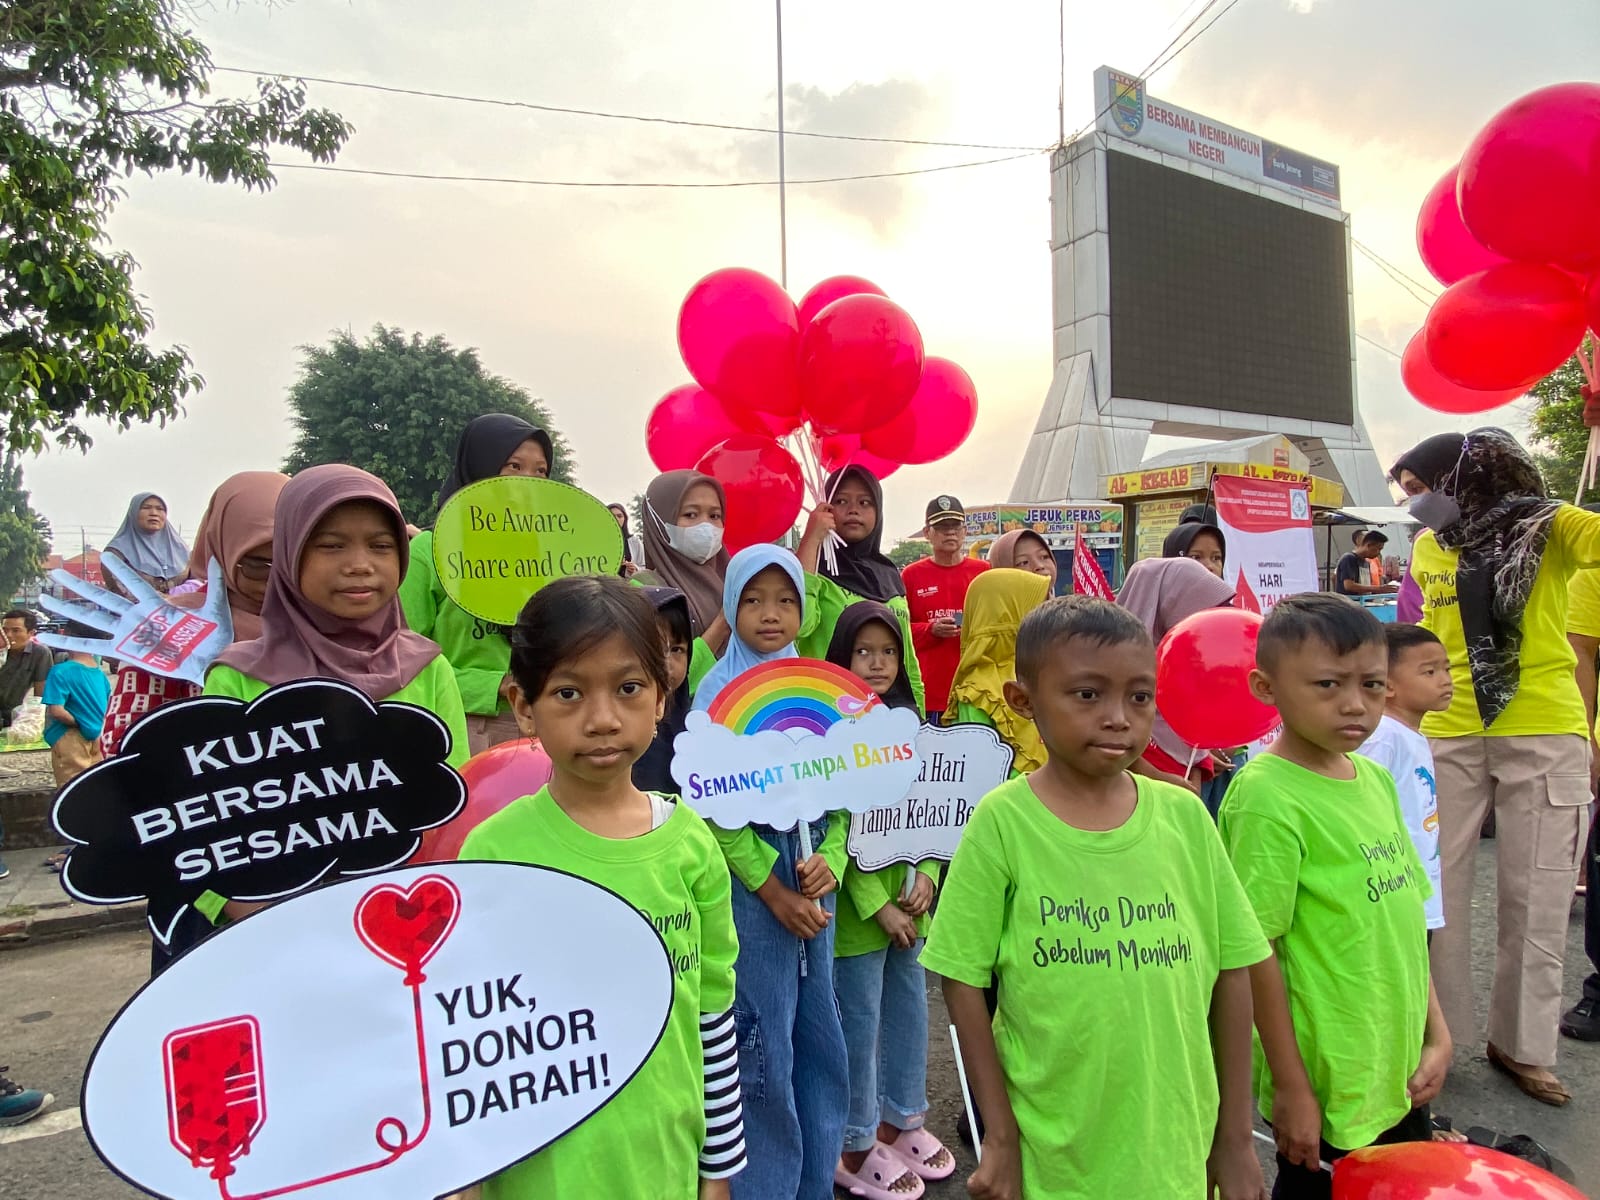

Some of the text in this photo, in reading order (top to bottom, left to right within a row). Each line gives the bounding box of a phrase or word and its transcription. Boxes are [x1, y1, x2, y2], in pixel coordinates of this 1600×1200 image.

[1147, 103, 1260, 158] BERSAMA MEMBANGUN
[1188, 139, 1225, 165] NEGERI
[1110, 477, 1128, 494] AL
[1140, 468, 1188, 491] KEBAB
[470, 505, 575, 535] Be Aware,
[972, 511, 997, 522] PERAS
[1024, 509, 1102, 523] JERUK PERAS
[447, 551, 608, 580] Share and Care
[1259, 573, 1283, 588] HARI
[132, 615, 168, 647] STOP
[148, 617, 209, 668] THALASSEMIA
[181, 716, 327, 776] KUAT
[930, 752, 966, 783] Hari
[131, 758, 404, 845] BERSAMA
[905, 798, 951, 829] Kelasi
[174, 808, 399, 881] SESAMA
[1039, 892, 1177, 933] Periksa Darah
[1033, 933, 1192, 971] Sebelum Menikah!
[435, 973, 537, 1026] YUK,
[441, 1008, 597, 1078] DONOR
[446, 1053, 611, 1128] DARAH!
